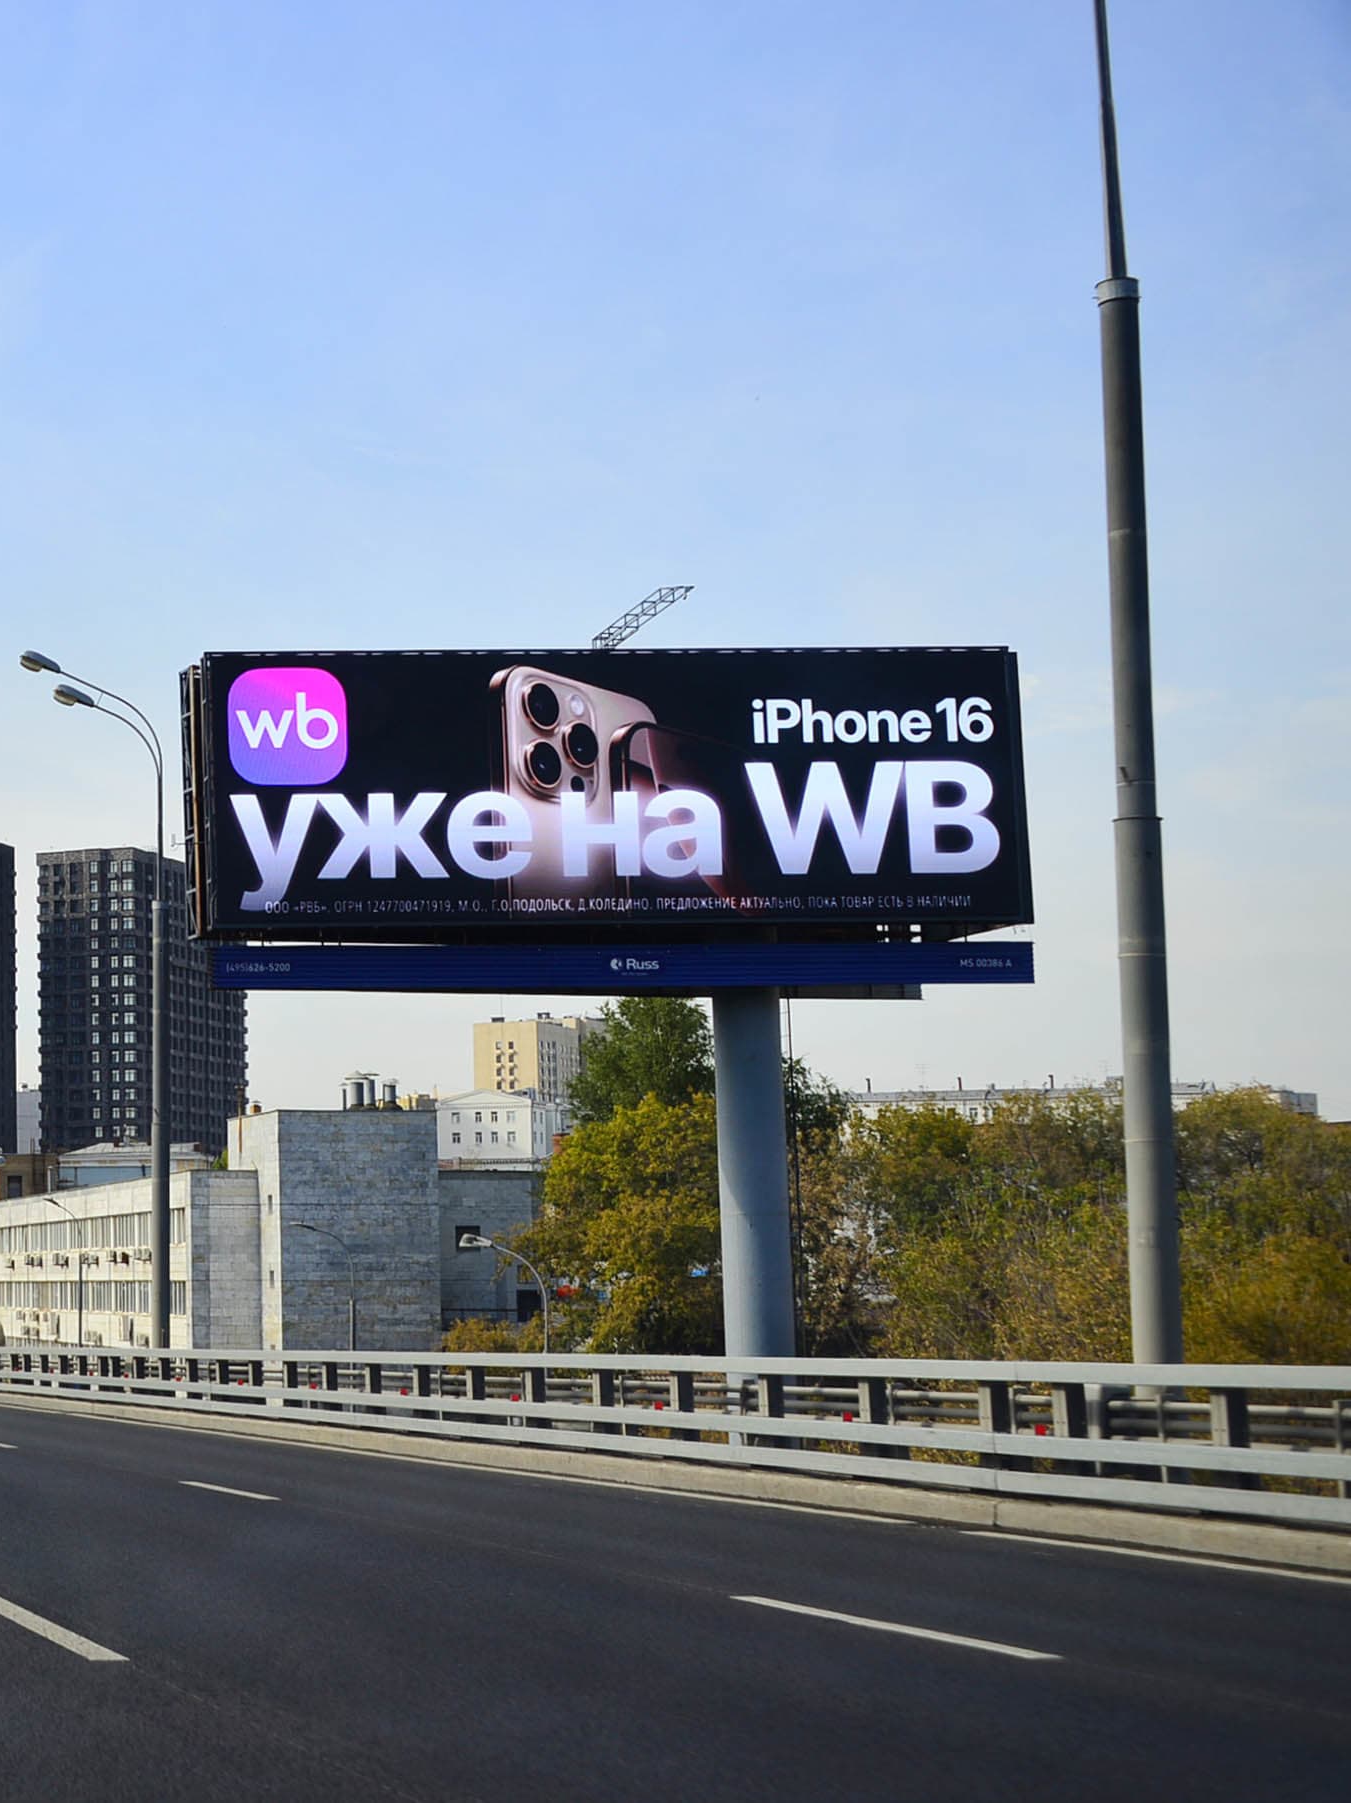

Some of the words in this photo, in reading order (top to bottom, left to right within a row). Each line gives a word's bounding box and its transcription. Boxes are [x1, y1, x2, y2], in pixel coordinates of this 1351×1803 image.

[235, 692, 339, 749] wb
[752, 698, 932, 744] iPhone
[935, 697, 994, 742] 16
[229, 790, 533, 911] уже
[560, 789, 723, 878] на
[744, 760, 1000, 875] WB
[265, 901, 289, 913] ООО
[334, 900, 363, 912] ОГРН
[656, 897, 736, 911] ПРЕДЛОЖЕНИЕ
[808, 896, 837, 909] ПОКА
[841, 896, 875, 908] ТОВАР
[878, 896, 904, 908] ЕСТЬ
[907, 896, 914, 908] В
[917, 895, 971, 907] НАЛИЧИИ
[626, 958, 660, 970] Russ
